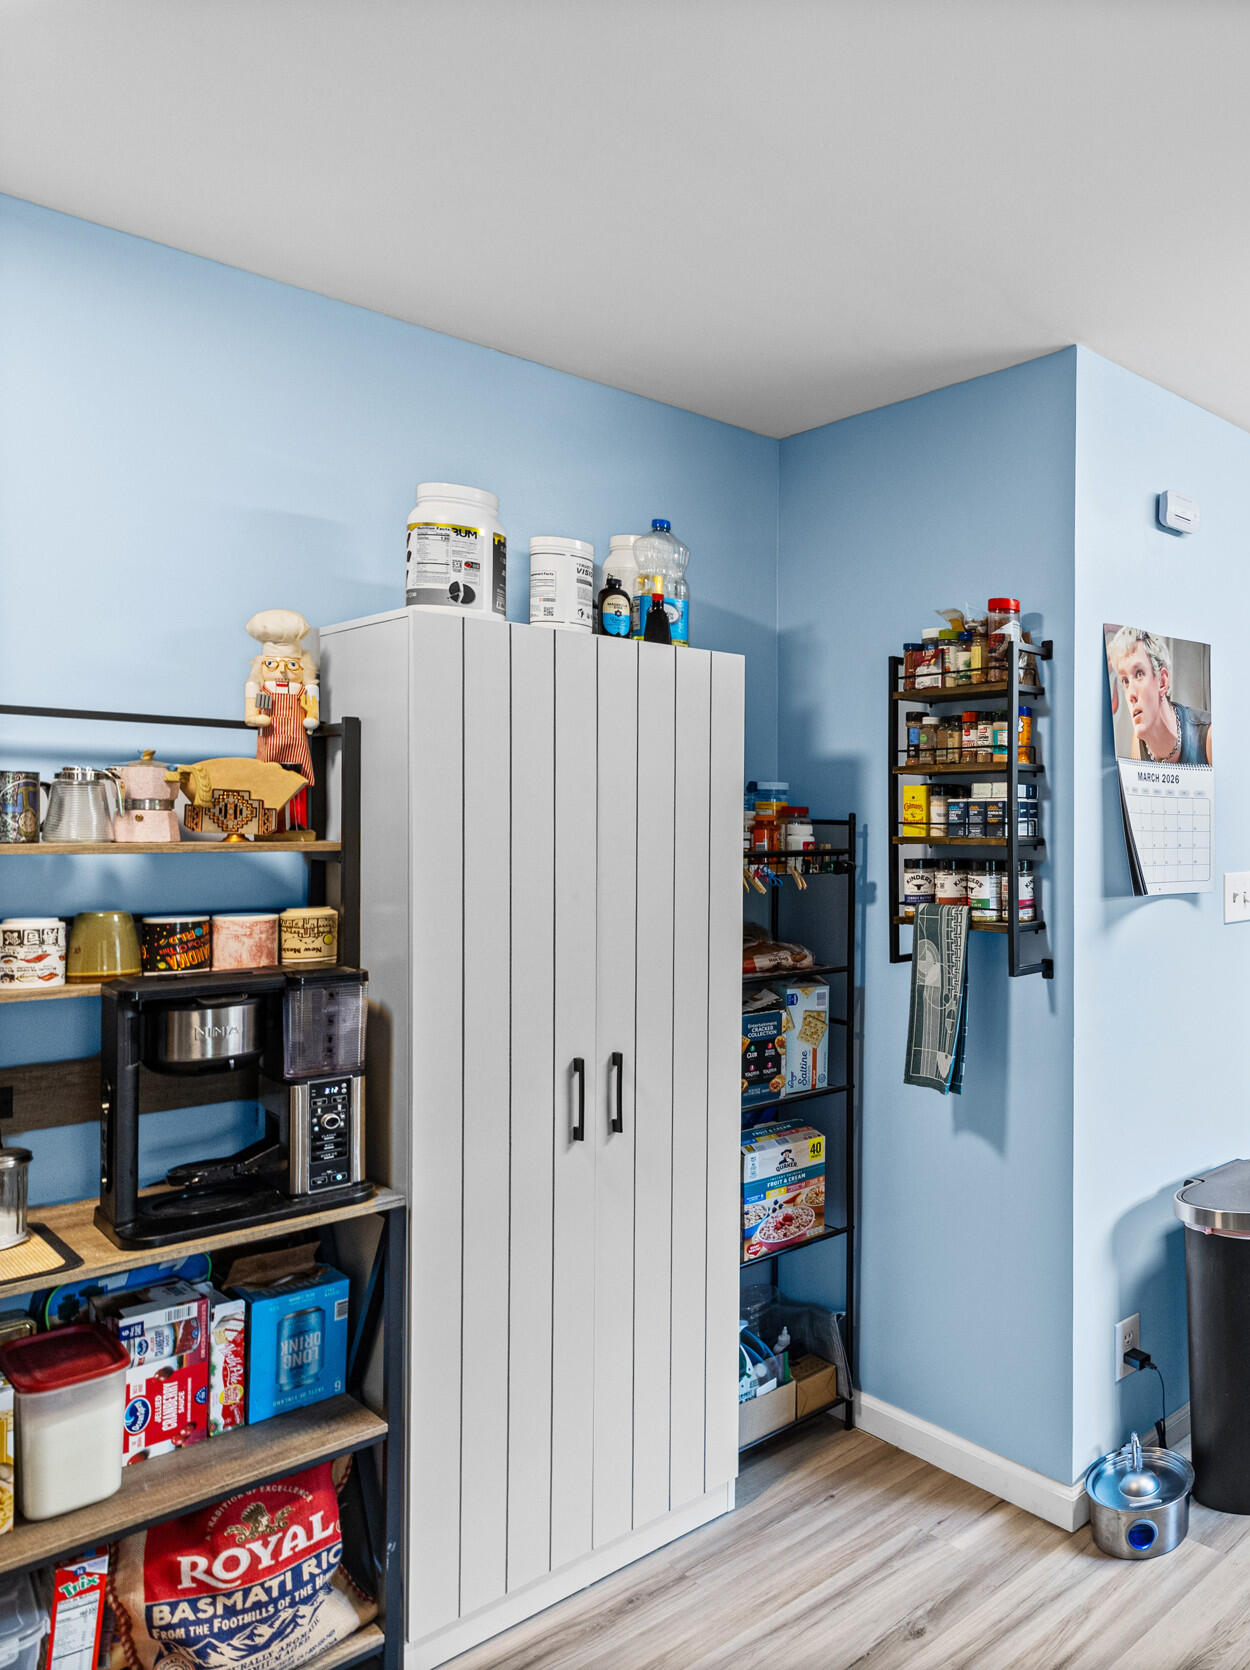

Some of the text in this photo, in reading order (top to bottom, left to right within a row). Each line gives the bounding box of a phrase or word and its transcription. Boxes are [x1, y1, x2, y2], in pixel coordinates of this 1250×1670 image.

[1137, 771, 1180, 784] MARCH 2026
[194, 1024, 240, 1041] NINJA
[747, 1030, 778, 1038] COLLECTION
[787, 1071, 798, 1089] Kroger
[797, 1050, 809, 1087] Saltine
[809, 1141, 822, 1155] 40
[775, 1161, 798, 1172] QUAKER
[766, 1179, 783, 1188] FRUIT
[788, 1173, 806, 1181] CREAM
[280, 1331, 321, 1357] DRINK
[282, 1346, 319, 1370] LONG
[334, 1380, 342, 1392] 6
[154, 1394, 162, 1424] JELLIED
[161, 1380, 178, 1432] CRANBERRY
[206, 1493, 246, 1533] TRADITION
[259, 1484, 314, 1503] EXCELLENCE
[177, 1510, 335, 1591] ROYAL
[58, 1575, 101, 1598] Trix
[152, 1570, 293, 1628] BASMATI
[301, 1542, 343, 1582] RIC
[152, 1585, 314, 1641] FROM THE FOOTHILLS OF THE
